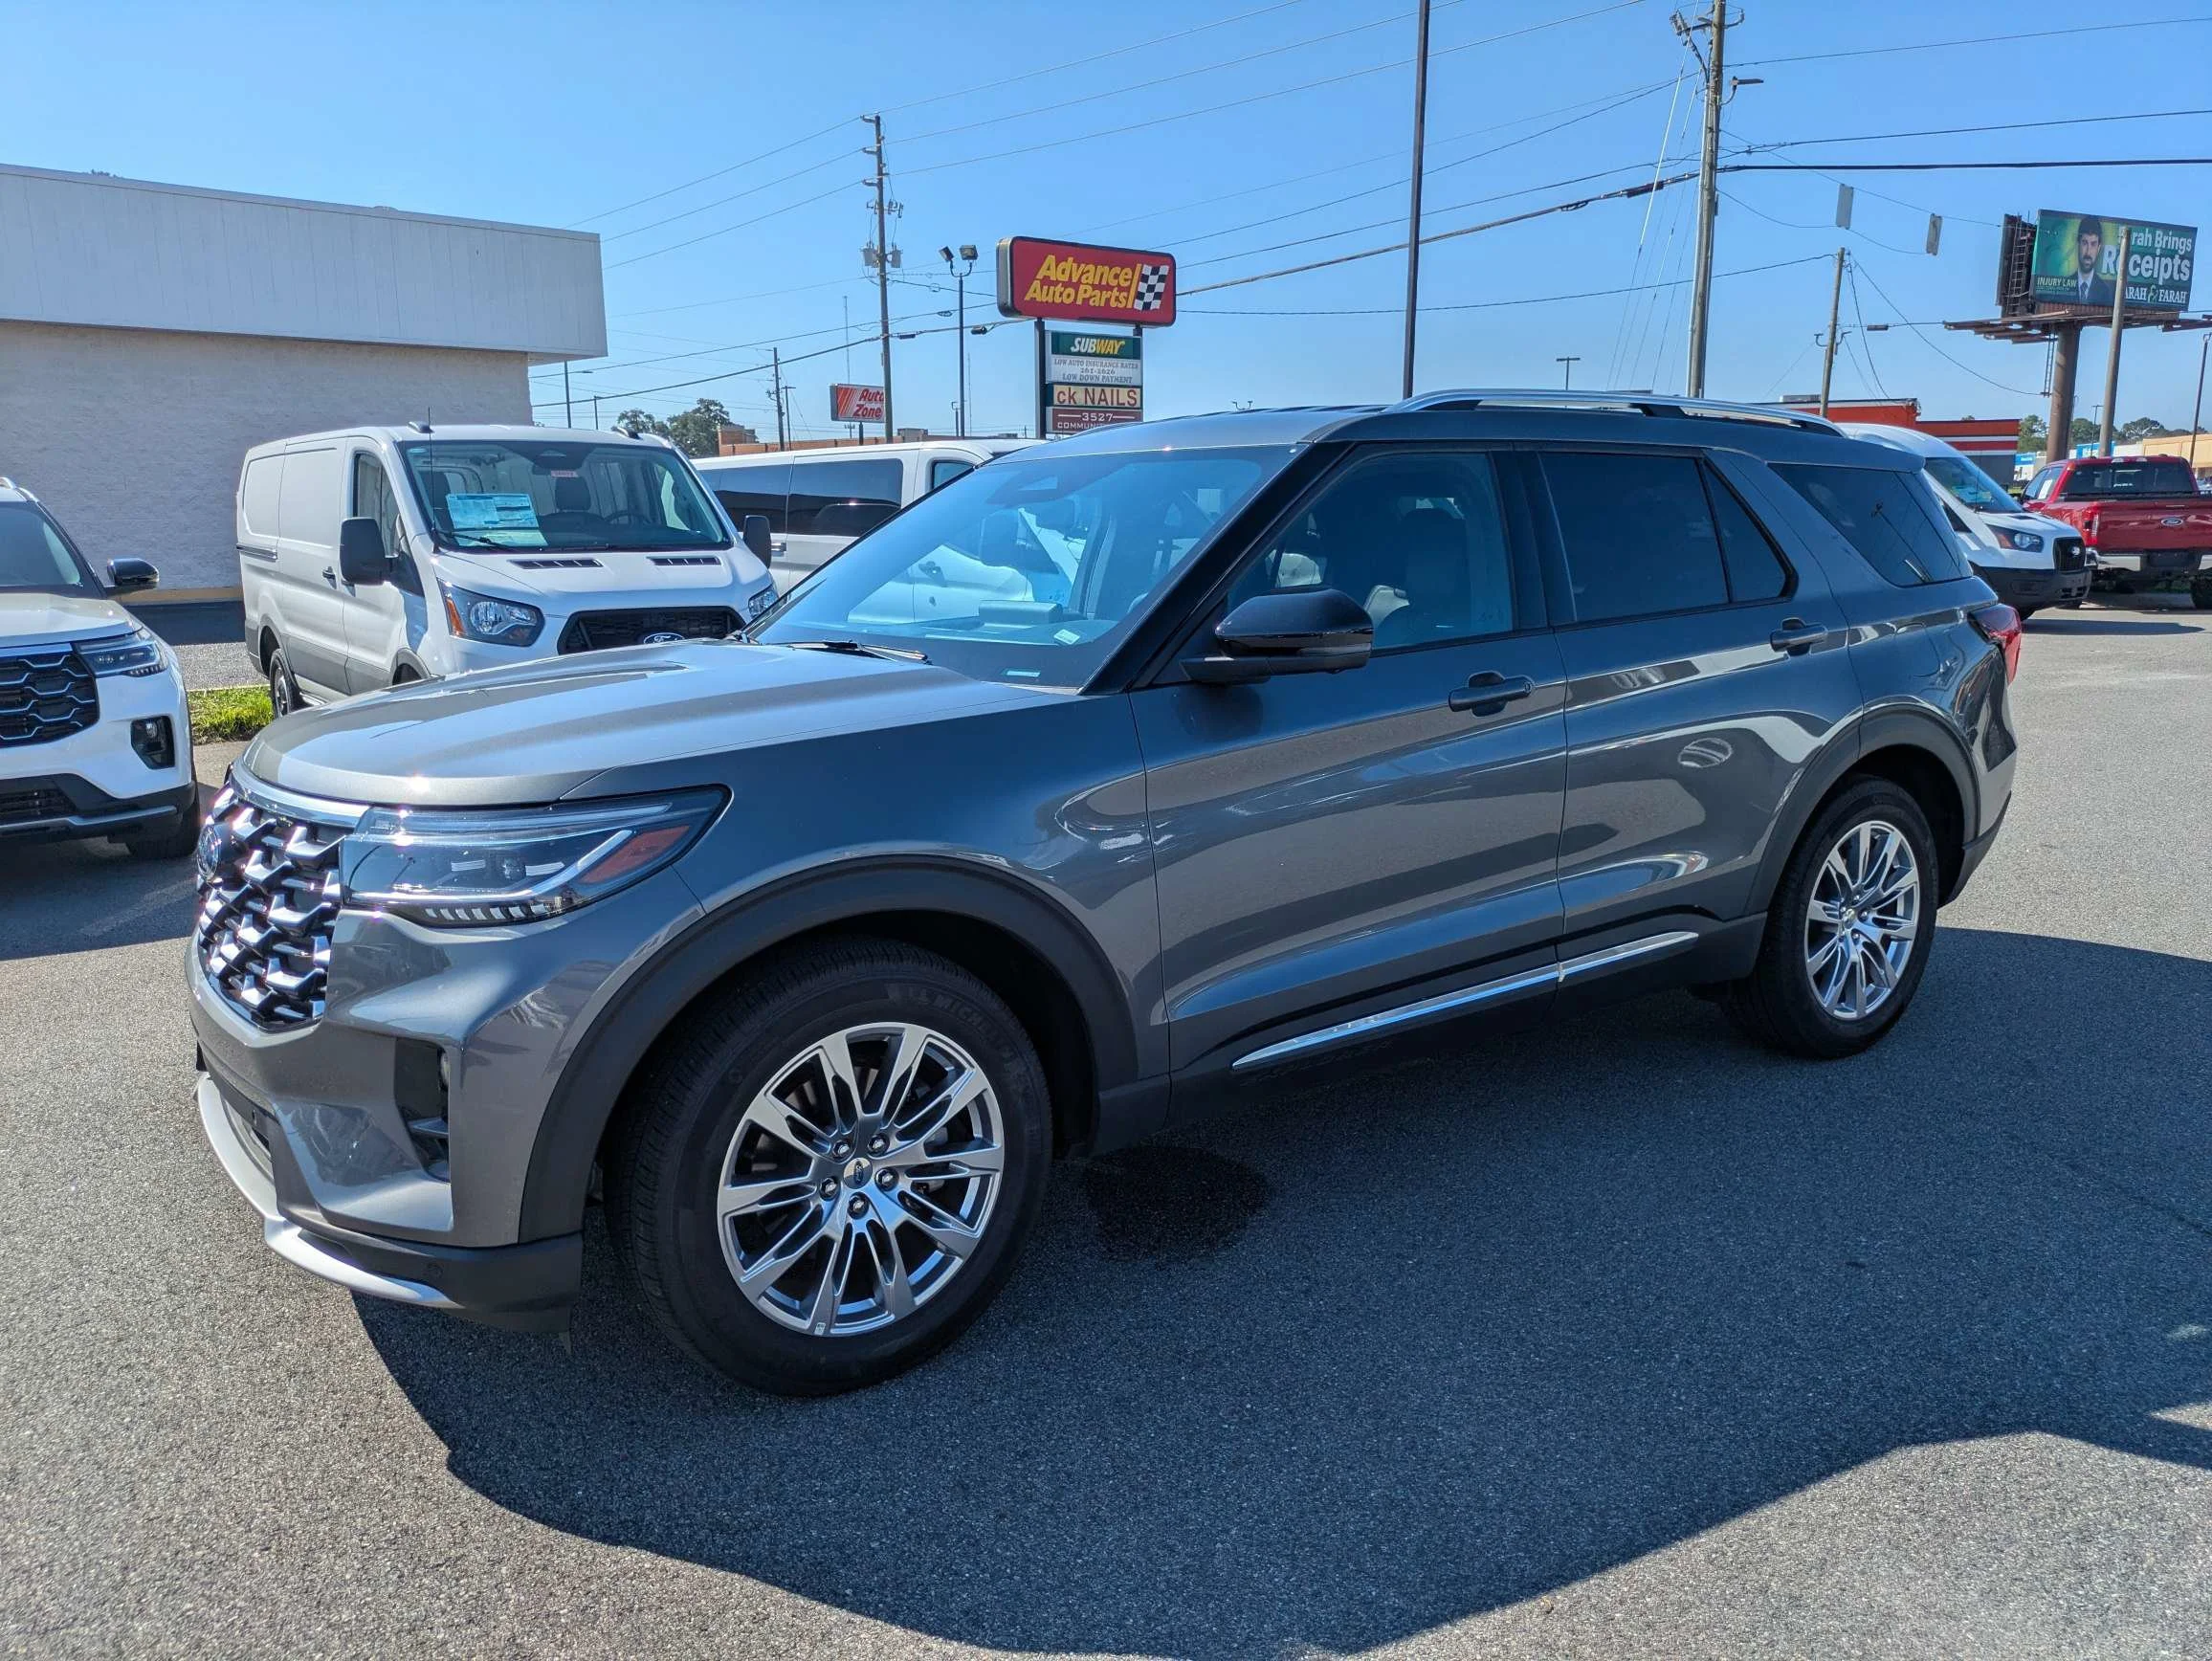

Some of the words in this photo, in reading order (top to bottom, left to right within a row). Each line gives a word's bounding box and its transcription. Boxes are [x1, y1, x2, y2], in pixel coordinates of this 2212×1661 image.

[2154, 230, 2192, 255] Brings
[1035, 255, 1133, 287] Advance
[2101, 245, 2191, 285] Rceipts
[2037, 277, 2062, 286] INJURY
[2062, 277, 2077, 287] LAW
[1025, 279, 1075, 304] Auto
[1075, 284, 1128, 308] Parts
[2125, 286, 2147, 300] ARAH
[2158, 289, 2187, 303] FARAH
[1070, 337, 1125, 355] SUBWAY
[1068, 359, 1085, 367] AUTO
[1062, 373, 1077, 382] LOW
[1079, 374, 1100, 383] DOWN
[1101, 375, 1133, 384] PAYMENT
[1056, 387, 1077, 405] ck
[1084, 388, 1138, 407] NAILS
[852, 404, 882, 417] Zone
[1081, 412, 1114, 422] 3527
